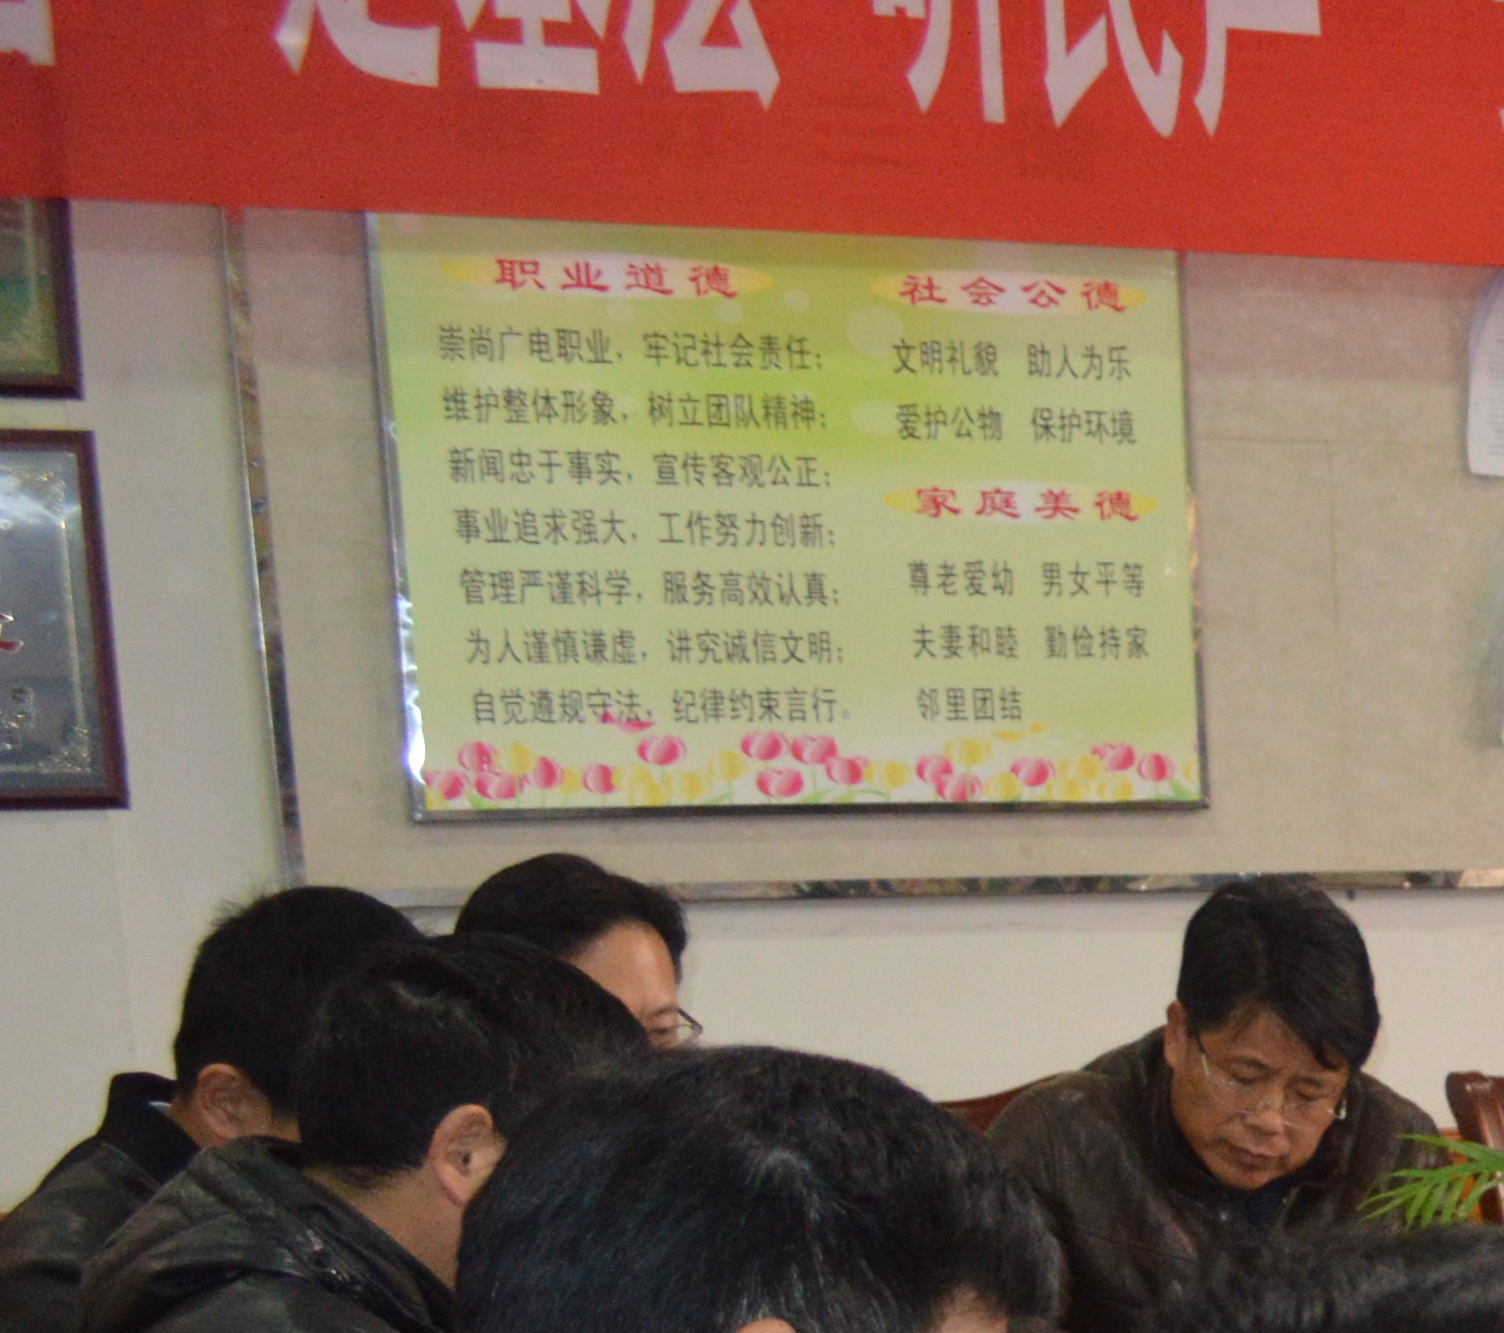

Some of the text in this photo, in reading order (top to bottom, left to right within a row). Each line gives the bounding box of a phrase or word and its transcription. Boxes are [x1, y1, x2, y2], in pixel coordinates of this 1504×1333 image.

[494, 257, 738, 299] 职业道德
[899, 274, 1128, 313] 社会公德
[892, 338, 1132, 382] 文明礼貌 助人为乐
[896, 402, 1137, 446] 爱护公物 保护环境
[915, 487, 1139, 522] 家庭美德
[908, 560, 1145, 599] 尊老爱幼 男女平等
[913, 623, 1150, 661] 夫妻和睦 勤俭持家
[916, 687, 1023, 722] 邻里团结
